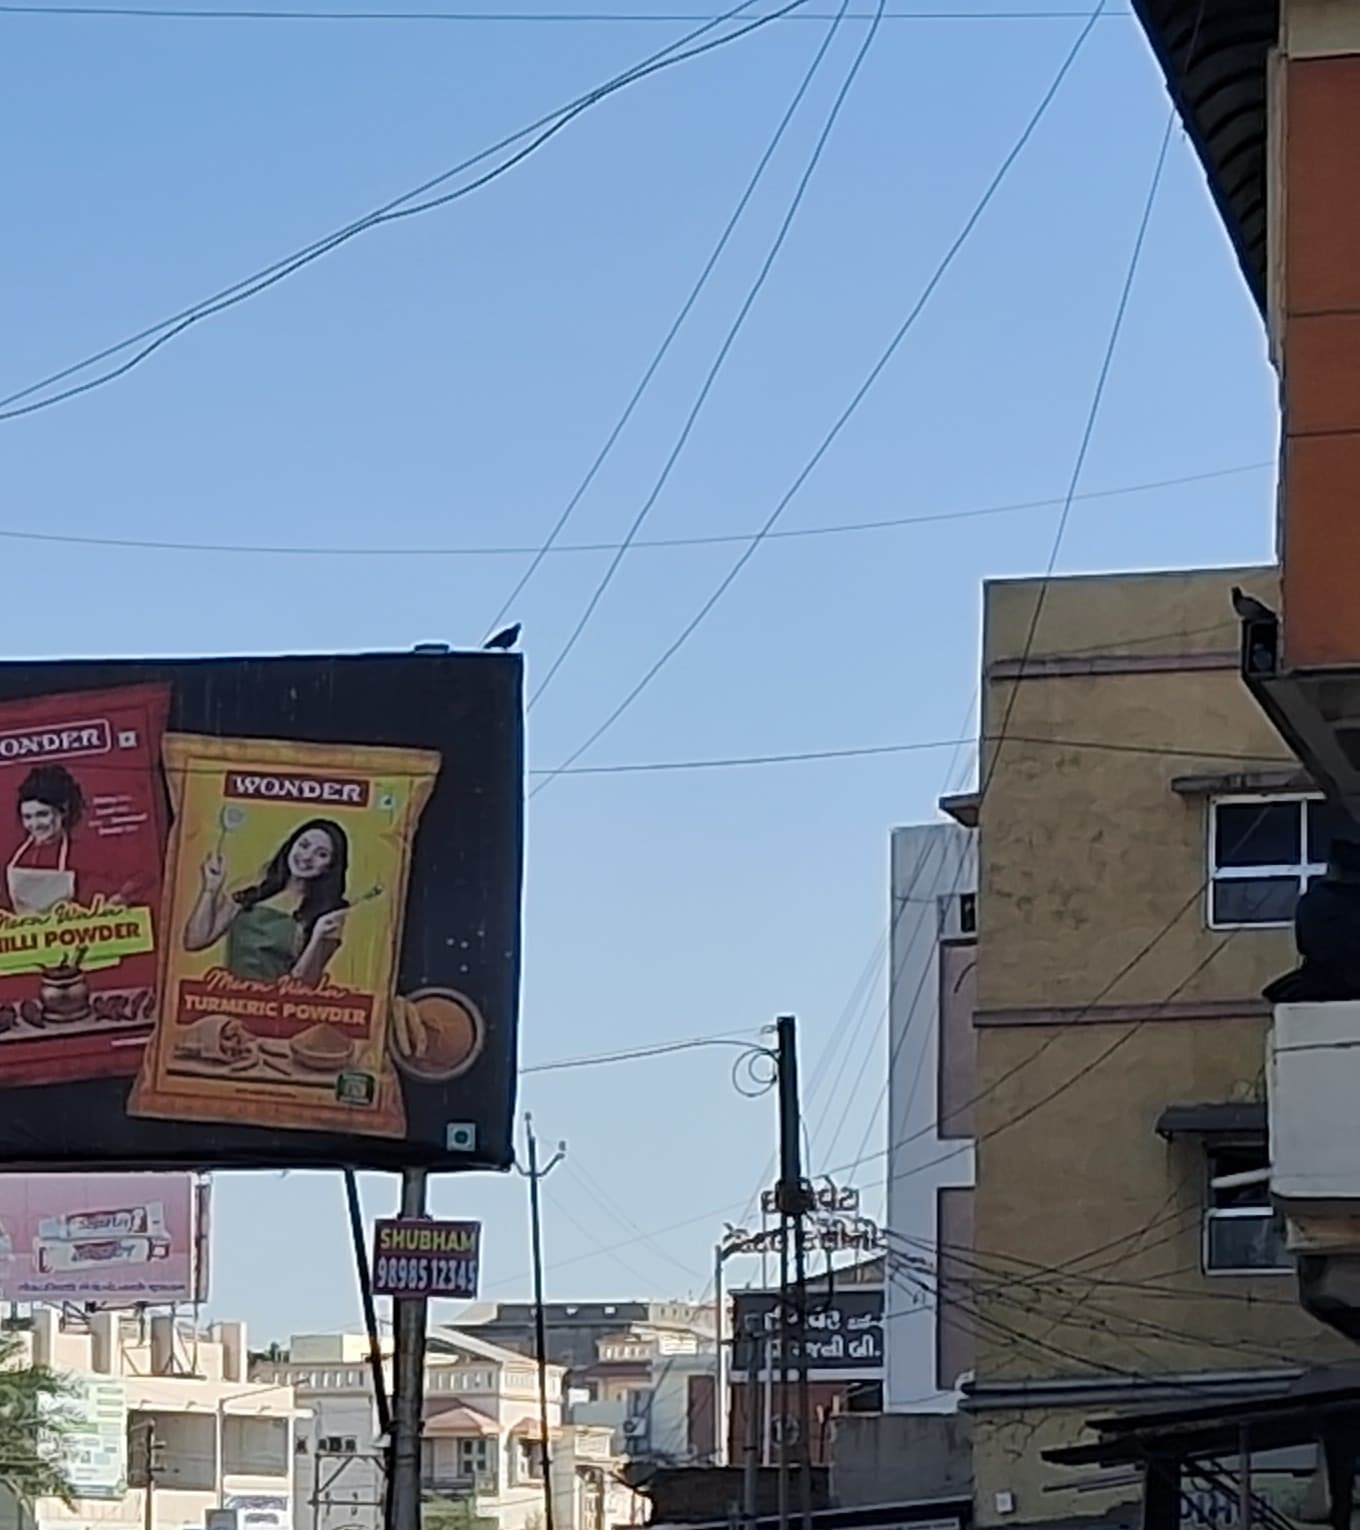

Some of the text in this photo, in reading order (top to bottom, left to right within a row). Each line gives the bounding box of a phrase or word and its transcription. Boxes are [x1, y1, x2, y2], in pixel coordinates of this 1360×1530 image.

[235, 776, 361, 801] WONDER
[45, 922, 141, 948] POWDER
[184, 995, 366, 1025] TURMERIC POWDER
[381, 1228, 476, 1252] SHUBHAM
